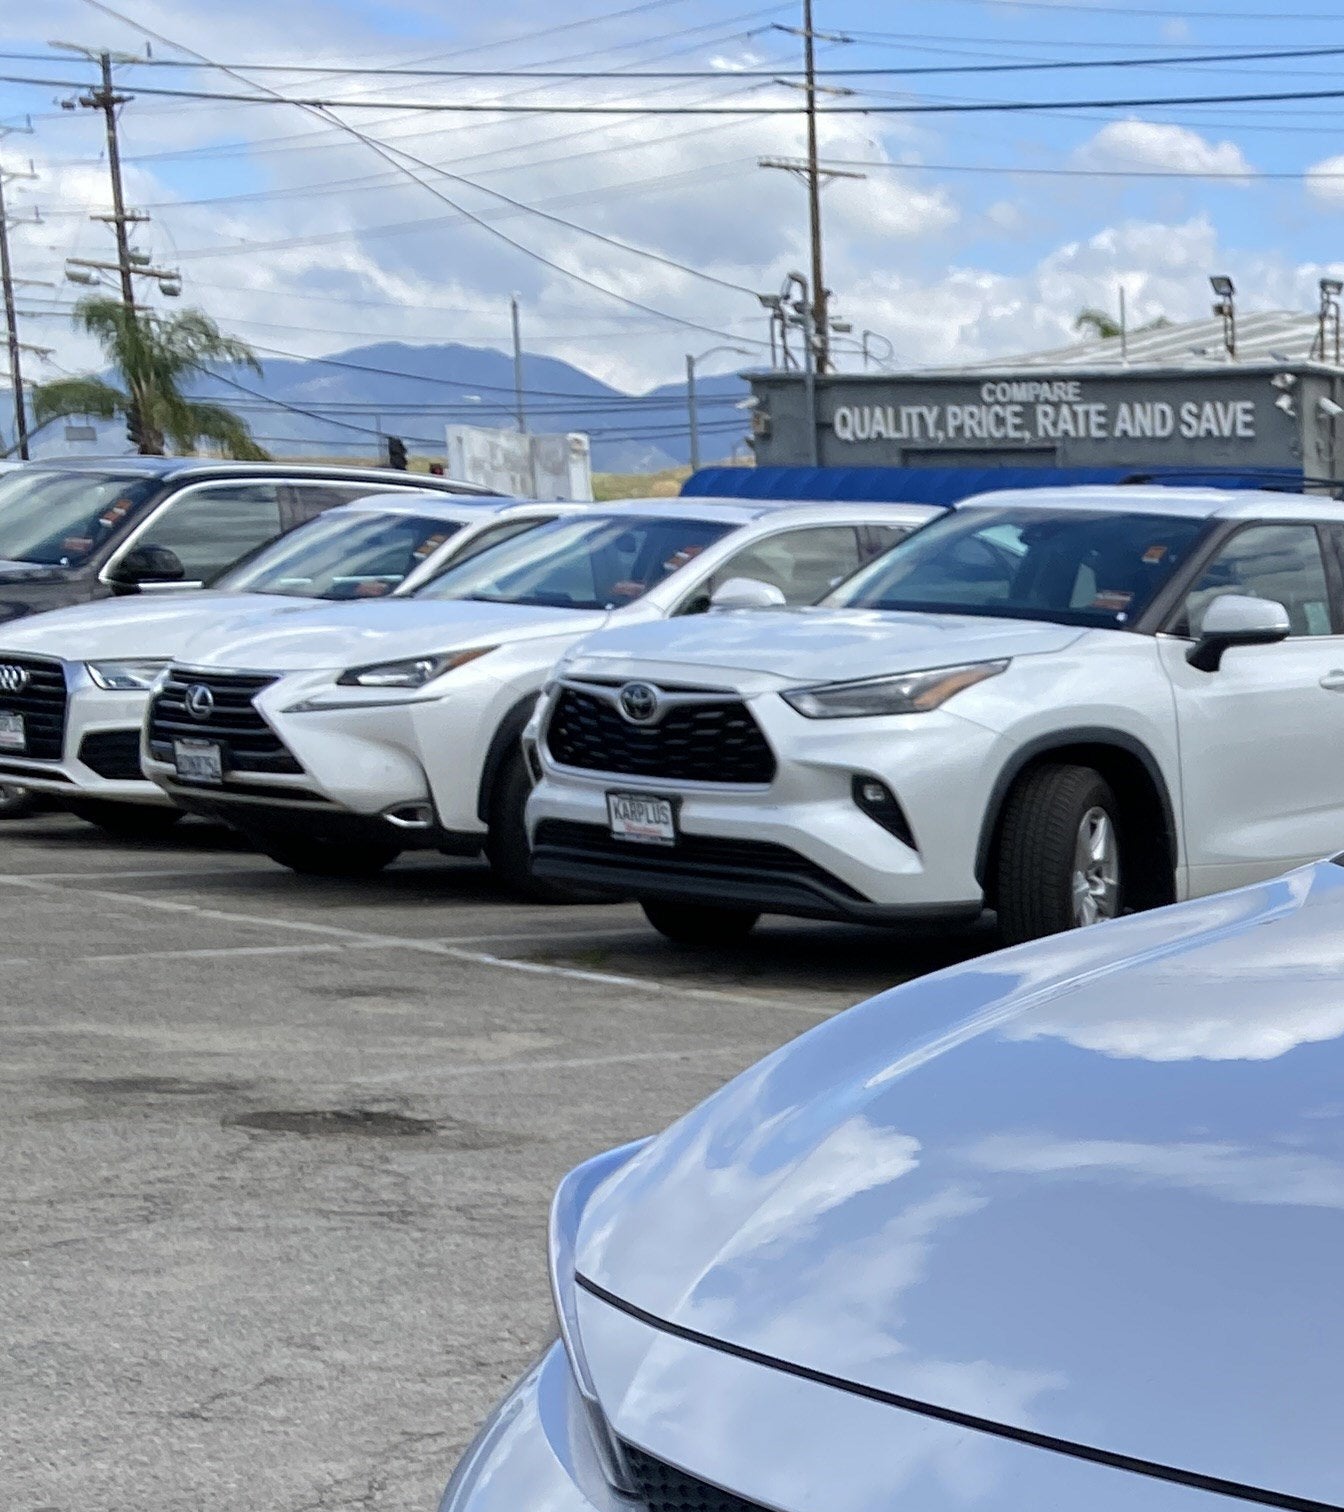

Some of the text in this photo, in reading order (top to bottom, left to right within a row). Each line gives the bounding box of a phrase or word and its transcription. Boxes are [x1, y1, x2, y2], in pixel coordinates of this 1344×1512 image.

[981, 381, 1081, 402] COMPARE
[834, 401, 1256, 443] QUALITY, PRICE, RATE AND SAVE
[613, 799, 669, 824] KARPLUS
